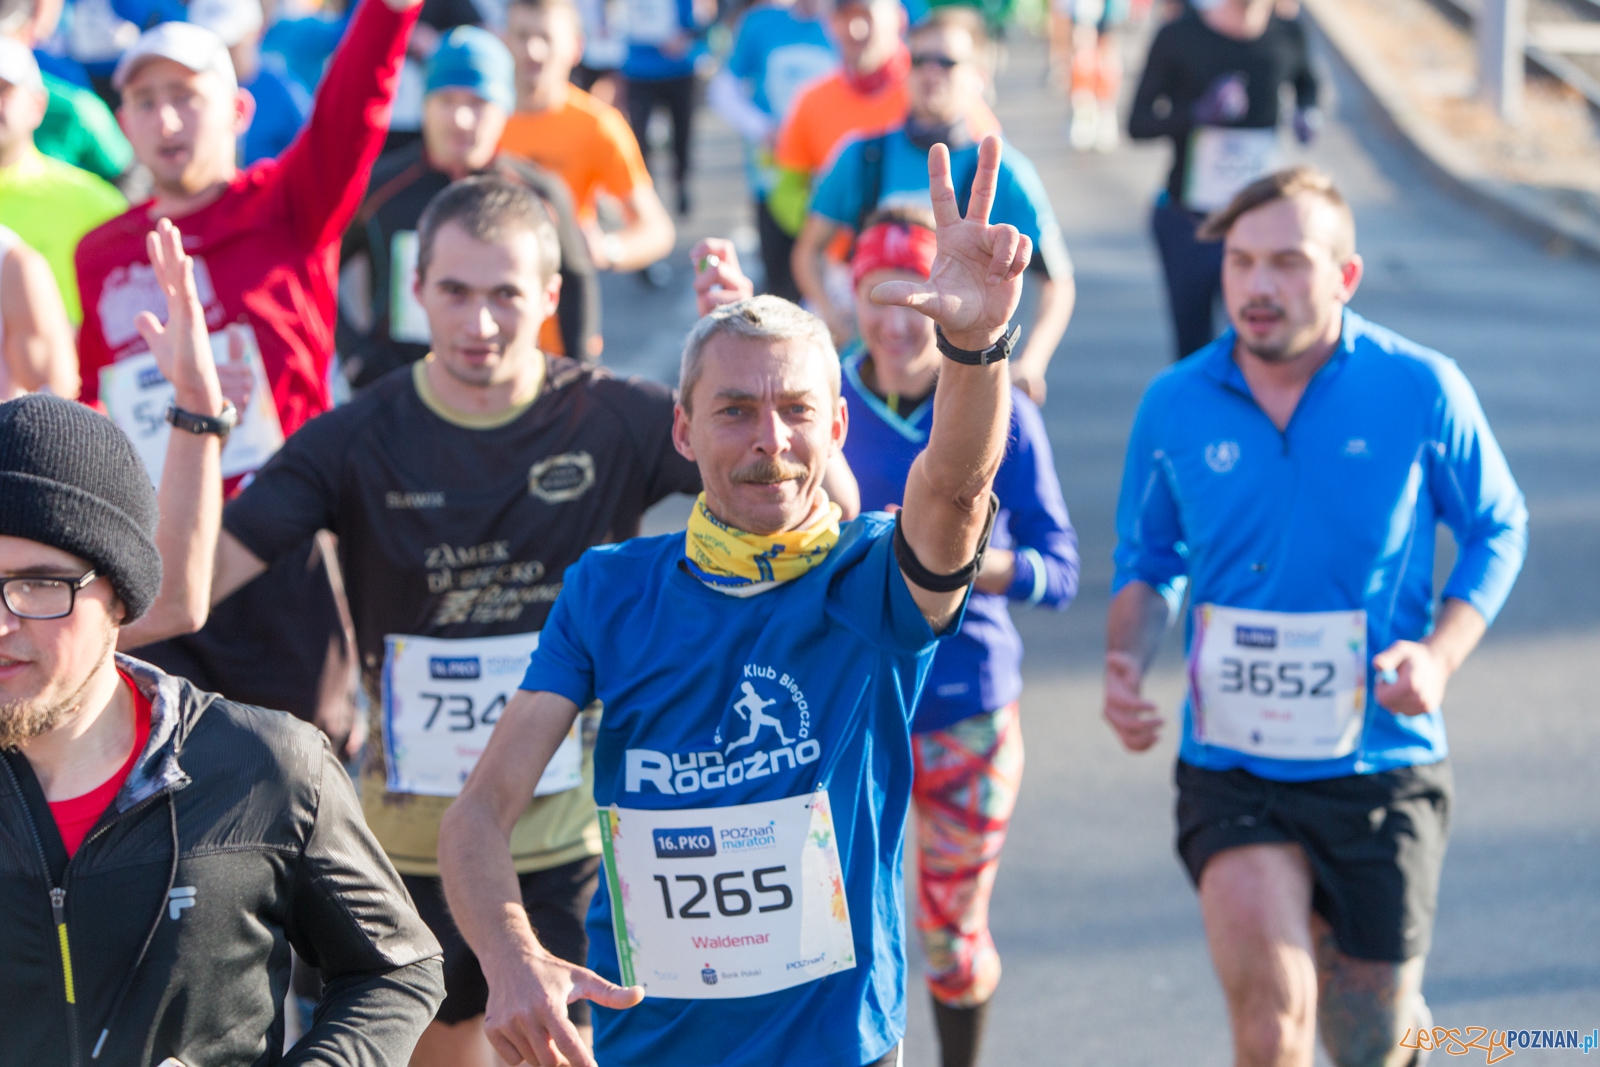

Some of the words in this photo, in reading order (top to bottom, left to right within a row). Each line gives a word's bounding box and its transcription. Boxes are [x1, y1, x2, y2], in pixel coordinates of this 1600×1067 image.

[1221, 656, 1336, 699] 3652
[419, 691, 508, 732] 734
[743, 664, 777, 680] Klub
[779, 672, 811, 740] Biegacza
[722, 834, 776, 850] maraton
[653, 865, 793, 919] 1265
[691, 933, 771, 950] Waldemar
